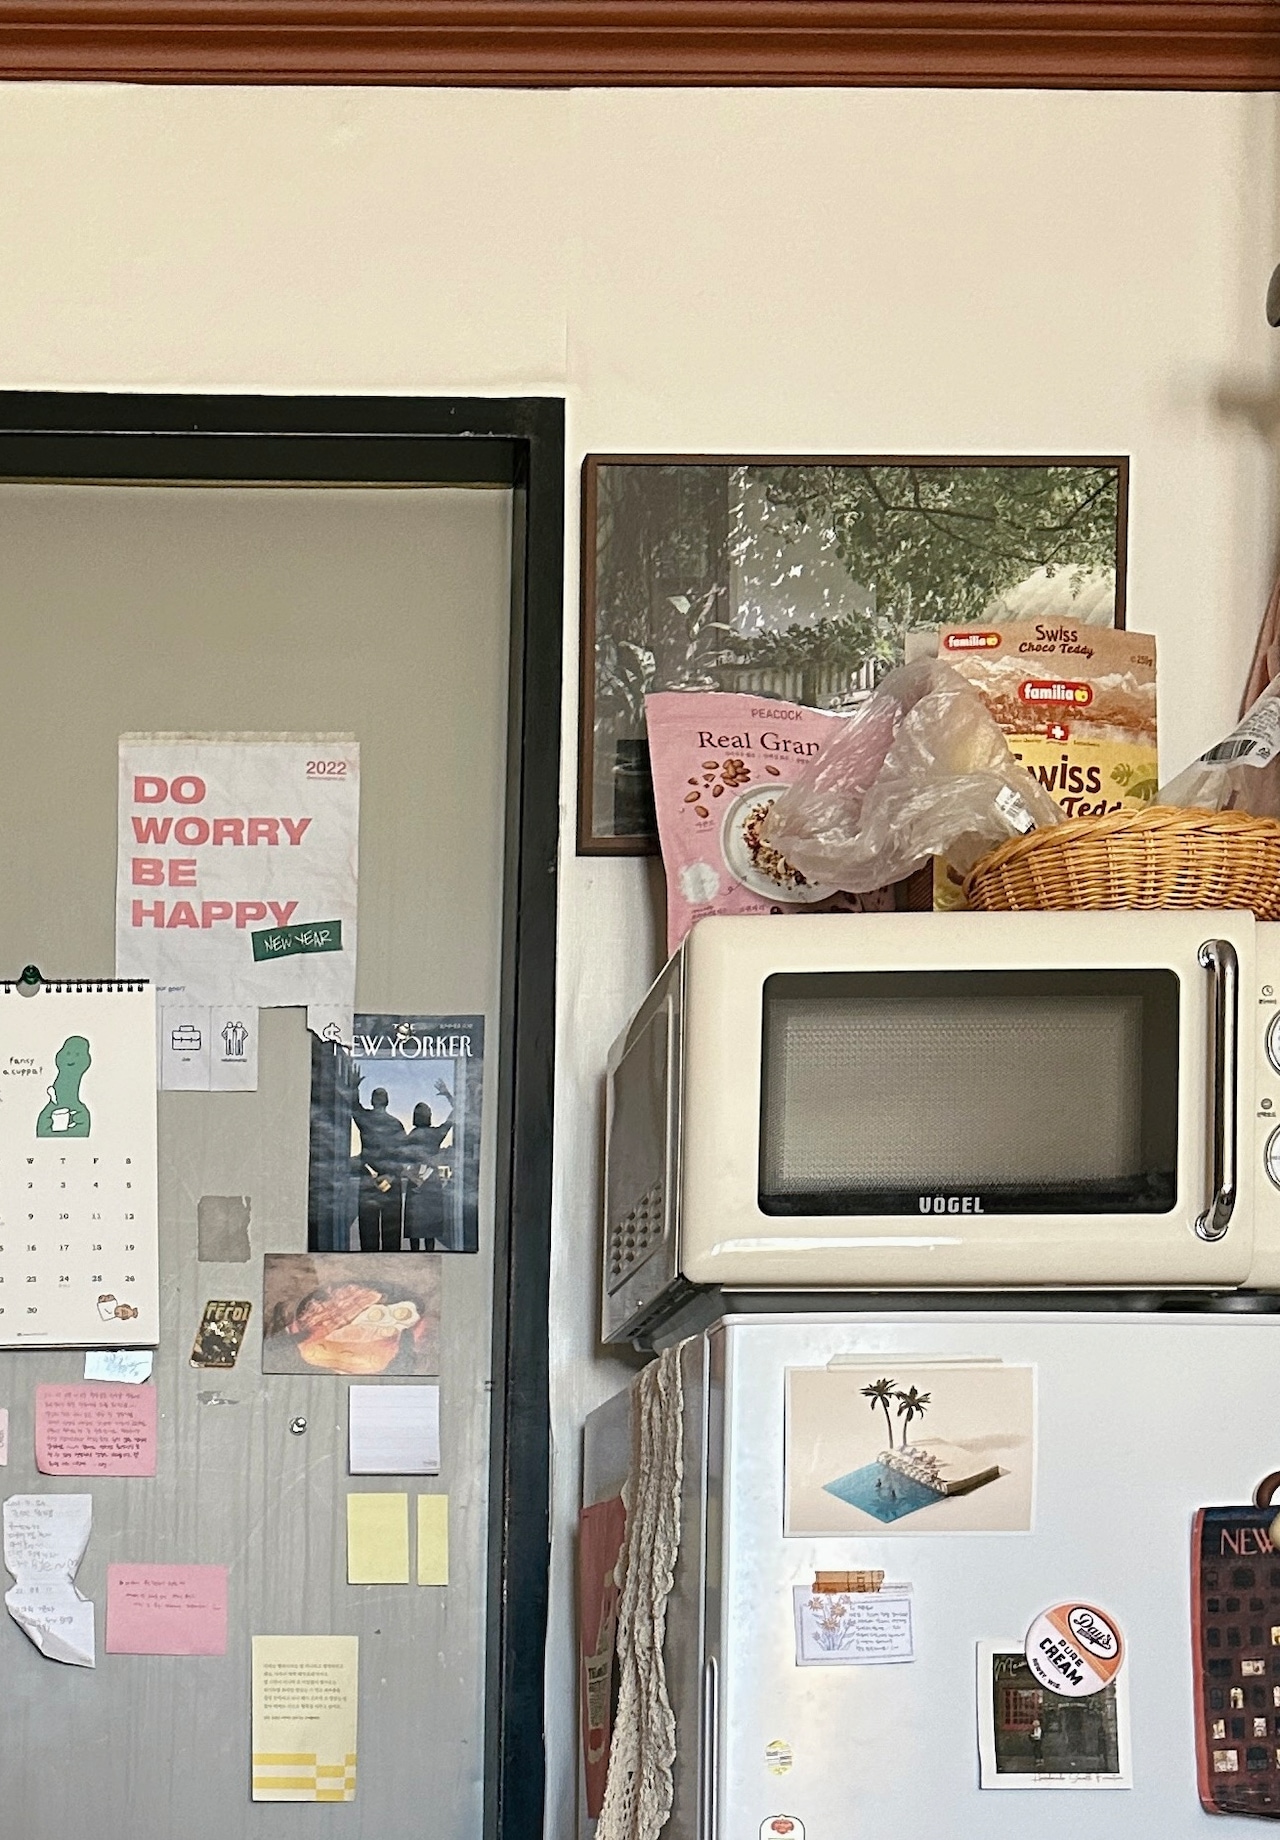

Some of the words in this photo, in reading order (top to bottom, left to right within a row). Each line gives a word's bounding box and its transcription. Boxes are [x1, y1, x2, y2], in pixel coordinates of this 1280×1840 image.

[948, 633, 986, 648] familia
[1035, 624, 1078, 643] Swiss
[1019, 642, 1056, 654] Choco
[1059, 643, 1095, 659] Teddy
[1023, 683, 1074, 701] familia
[751, 708, 803, 721] PEACOCK
[698, 731, 752, 749] Real
[306, 760, 347, 775] 2022
[134, 776, 206, 804] DO
[1058, 797, 1122, 818] Tedd
[131, 816, 313, 846] WORRY
[131, 857, 198, 887] BE
[131, 899, 299, 929] HAPPY
[263, 933, 292, 952] NEW
[295, 929, 332, 947] YEAR
[387, 1035, 473, 1058] YORKER
[9, 1056, 35, 1066] fancy
[919, 1194, 984, 1213] VÖGEL
[1039, 1637, 1084, 1686] CREAM
[1057, 1639, 1084, 1667] PURE
